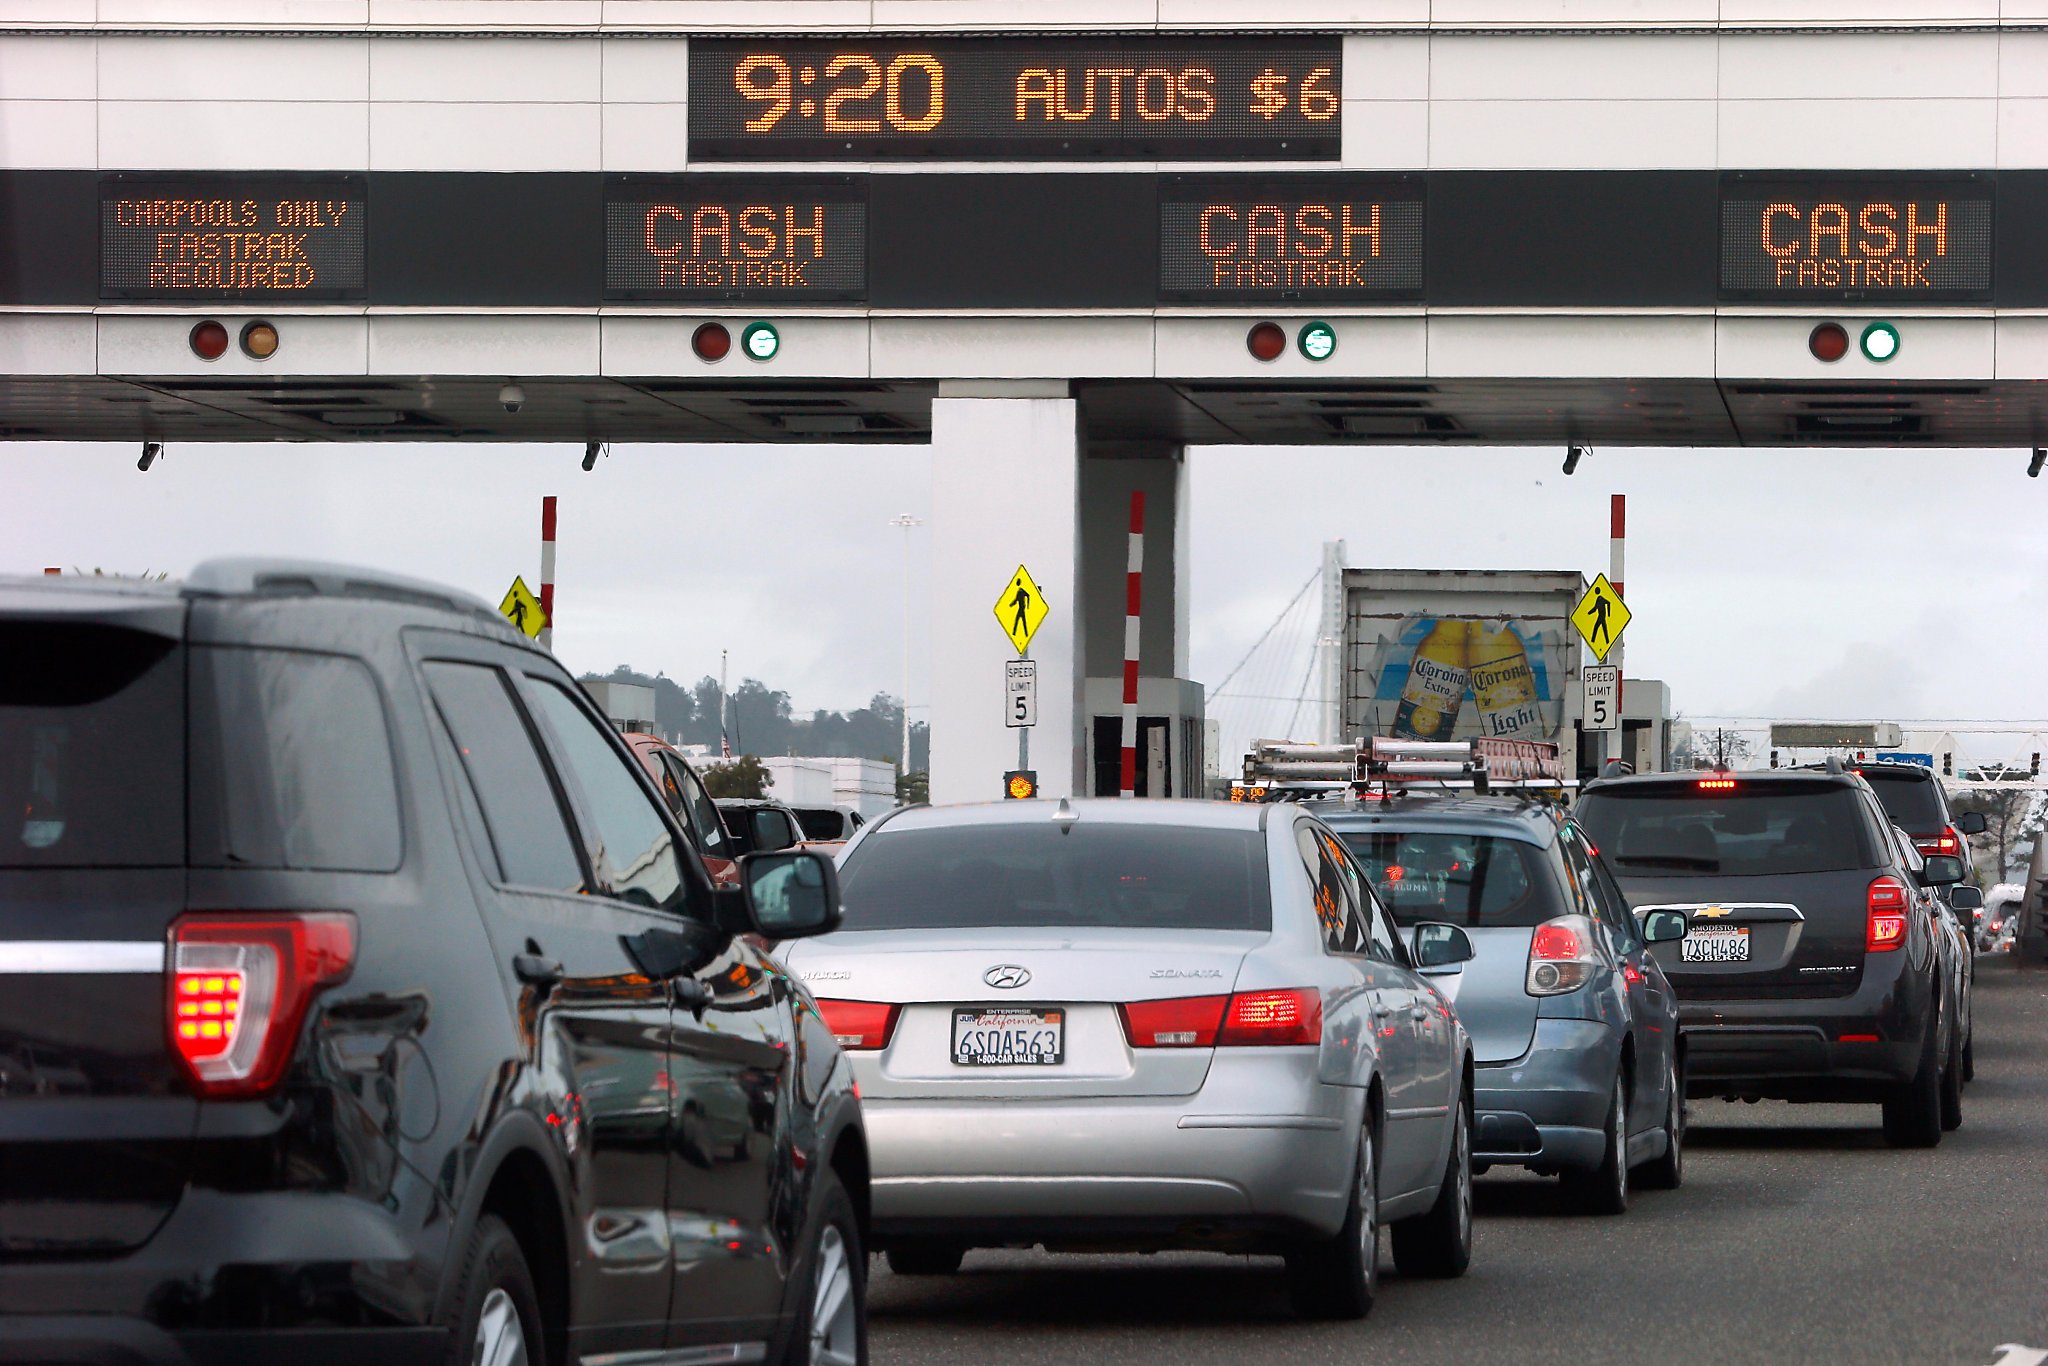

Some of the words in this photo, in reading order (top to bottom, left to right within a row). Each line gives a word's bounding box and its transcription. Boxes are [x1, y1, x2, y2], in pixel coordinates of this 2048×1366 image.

[733, 52, 945, 132] 9:20
[1015, 67, 1216, 121] AUTOS
[117, 200, 257, 226] CARPOOLS
[276, 201, 347, 227] ONLY
[646, 205, 824, 258] CASH
[1199, 204, 1380, 257] CASH
[1761, 203, 1948, 256] CASH
[157, 233, 308, 259] FASTRAK
[150, 262, 315, 289] REQUIRED
[660, 260, 809, 286] FASTRAK
[1213, 260, 1366, 286] FASTRAK
[1775, 259, 1931, 286] FASTRAK
[1008, 667, 1033, 678] SPEED
[1415, 659, 1464, 685] Corona
[1473, 664, 1528, 692] Corona
[1586, 672, 1615, 682] SPEED
[1010, 682, 1031, 692] LIMIT
[1424, 678, 1450, 696] Extra
[1588, 686, 1611, 696] LIMIT
[1015, 696, 1027, 720] 5
[1489, 706, 1535, 736] Light
[1593, 700, 1607, 723] 5
[1682, 954, 1748, 962] ROBERTS
[1684, 939, 1746, 956] 7XCH486
[1149, 969, 1223, 979] SONATA
[976, 1013, 1040, 1030] California
[976, 1054, 1014, 1064] 1-800-CAR
[1014, 1054, 1038, 1063] SALES
